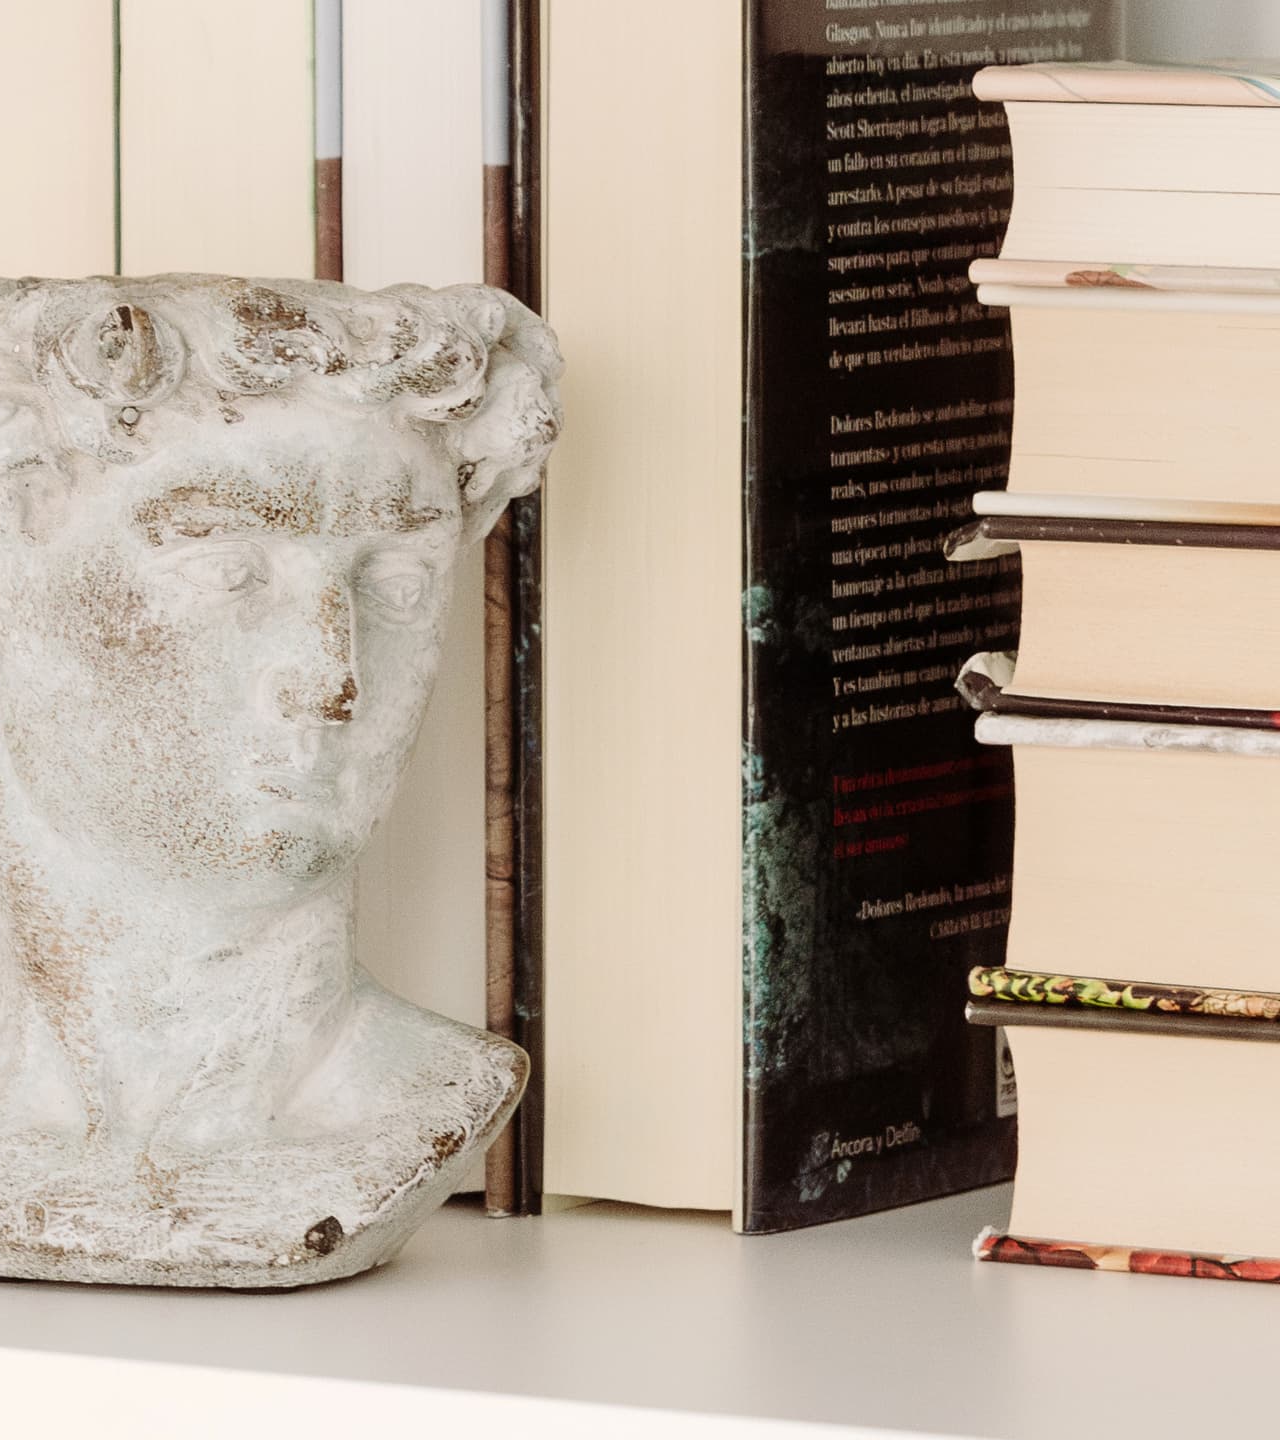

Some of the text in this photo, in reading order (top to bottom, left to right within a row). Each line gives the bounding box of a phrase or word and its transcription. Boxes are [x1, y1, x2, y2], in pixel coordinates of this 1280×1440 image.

[875, 21, 908, 38] Nunca
[910, 18, 926, 37] fue
[928, 15, 986, 35] identificado
[987, 19, 993, 36] y
[995, 13, 1005, 31] el
[826, 56, 865, 74] abierto
[867, 54, 884, 76] hoy
[887, 57, 900, 70] en
[923, 49, 938, 69] En
[940, 51, 960, 66] esta
[826, 84, 911, 107] años ochenta, el
[826, 122, 856, 140] Scott
[857, 118, 919, 139] Sherrington
[921, 115, 947, 136] logra
[948, 112, 976, 133] llegar
[828, 160, 842, 172] un
[844, 152, 869, 172] fallo
[870, 156, 884, 168] en
[885, 154, 899, 168] su
[900, 146, 941, 167] corazón
[942, 149, 955, 163] en
[956, 144, 966, 162] el
[827, 183, 886, 205] arrestarlo.
[886, 183, 895, 201] A
[895, 184, 925, 205] pesar
[926, 178, 939, 196] de
[940, 182, 952, 194] su
[827, 225, 835, 243] y
[836, 220, 873, 237] contra
[874, 216, 890, 234] los
[891, 216, 936, 234] consejos
[827, 254, 886, 274] superiores
[886, 251, 910, 270] para
[911, 249, 930, 266] que
[828, 284, 870, 304] asesino
[871, 286, 886, 299] en
[887, 279, 915, 297] serie,
[917, 274, 945, 294] Noah
[868, 314, 897, 332] hasta
[898, 310, 909, 328] el
[910, 309, 944, 328] Bilbao
[945, 305, 959, 323] de
[829, 350, 843, 368] de
[844, 353, 865, 371] que
[866, 352, 882, 364] un
[883, 342, 936, 362] verdadero
[830, 415, 873, 434] Dolores
[874, 406, 921, 429] Redondo
[921, 411, 935, 422] se
[892, 446, 900, 463] y
[901, 444, 921, 458] con
[922, 440, 944, 454] esta
[831, 480, 867, 500] reales,
[868, 482, 889, 495] nos
[889, 472, 933, 491] conduce
[934, 468, 962, 486] hasta
[963, 464, 973, 481] el
[831, 501, 950, 534] mayores tormentas del
[831, 551, 853, 565] una
[854, 544, 887, 566] época
[888, 544, 902, 557] en
[832, 576, 884, 598] homenaje
[885, 578, 894, 590] a
[895, 571, 906, 589] la
[906, 567, 944, 586] cultura
[832, 616, 848, 630] un
[848, 609, 887, 629] tiempo
[888, 608, 902, 621] en
[903, 602, 914, 620] el
[914, 605, 934, 621] que
[935, 598, 945, 615] la
[832, 645, 882, 663] ventanas
[883, 637, 926, 655] abiertas
[927, 630, 937, 648] al
[833, 677, 842, 696] Y
[843, 681, 857, 693] es
[858, 670, 902, 692] también
[903, 671, 919, 685] un
[833, 715, 841, 733] y
[842, 714, 851, 727] a
[851, 708, 869, 725] las
[869, 702, 917, 723] historias
[917, 697, 931, 714] de
[831, 1121, 921, 1158] Áncora y Delfín
